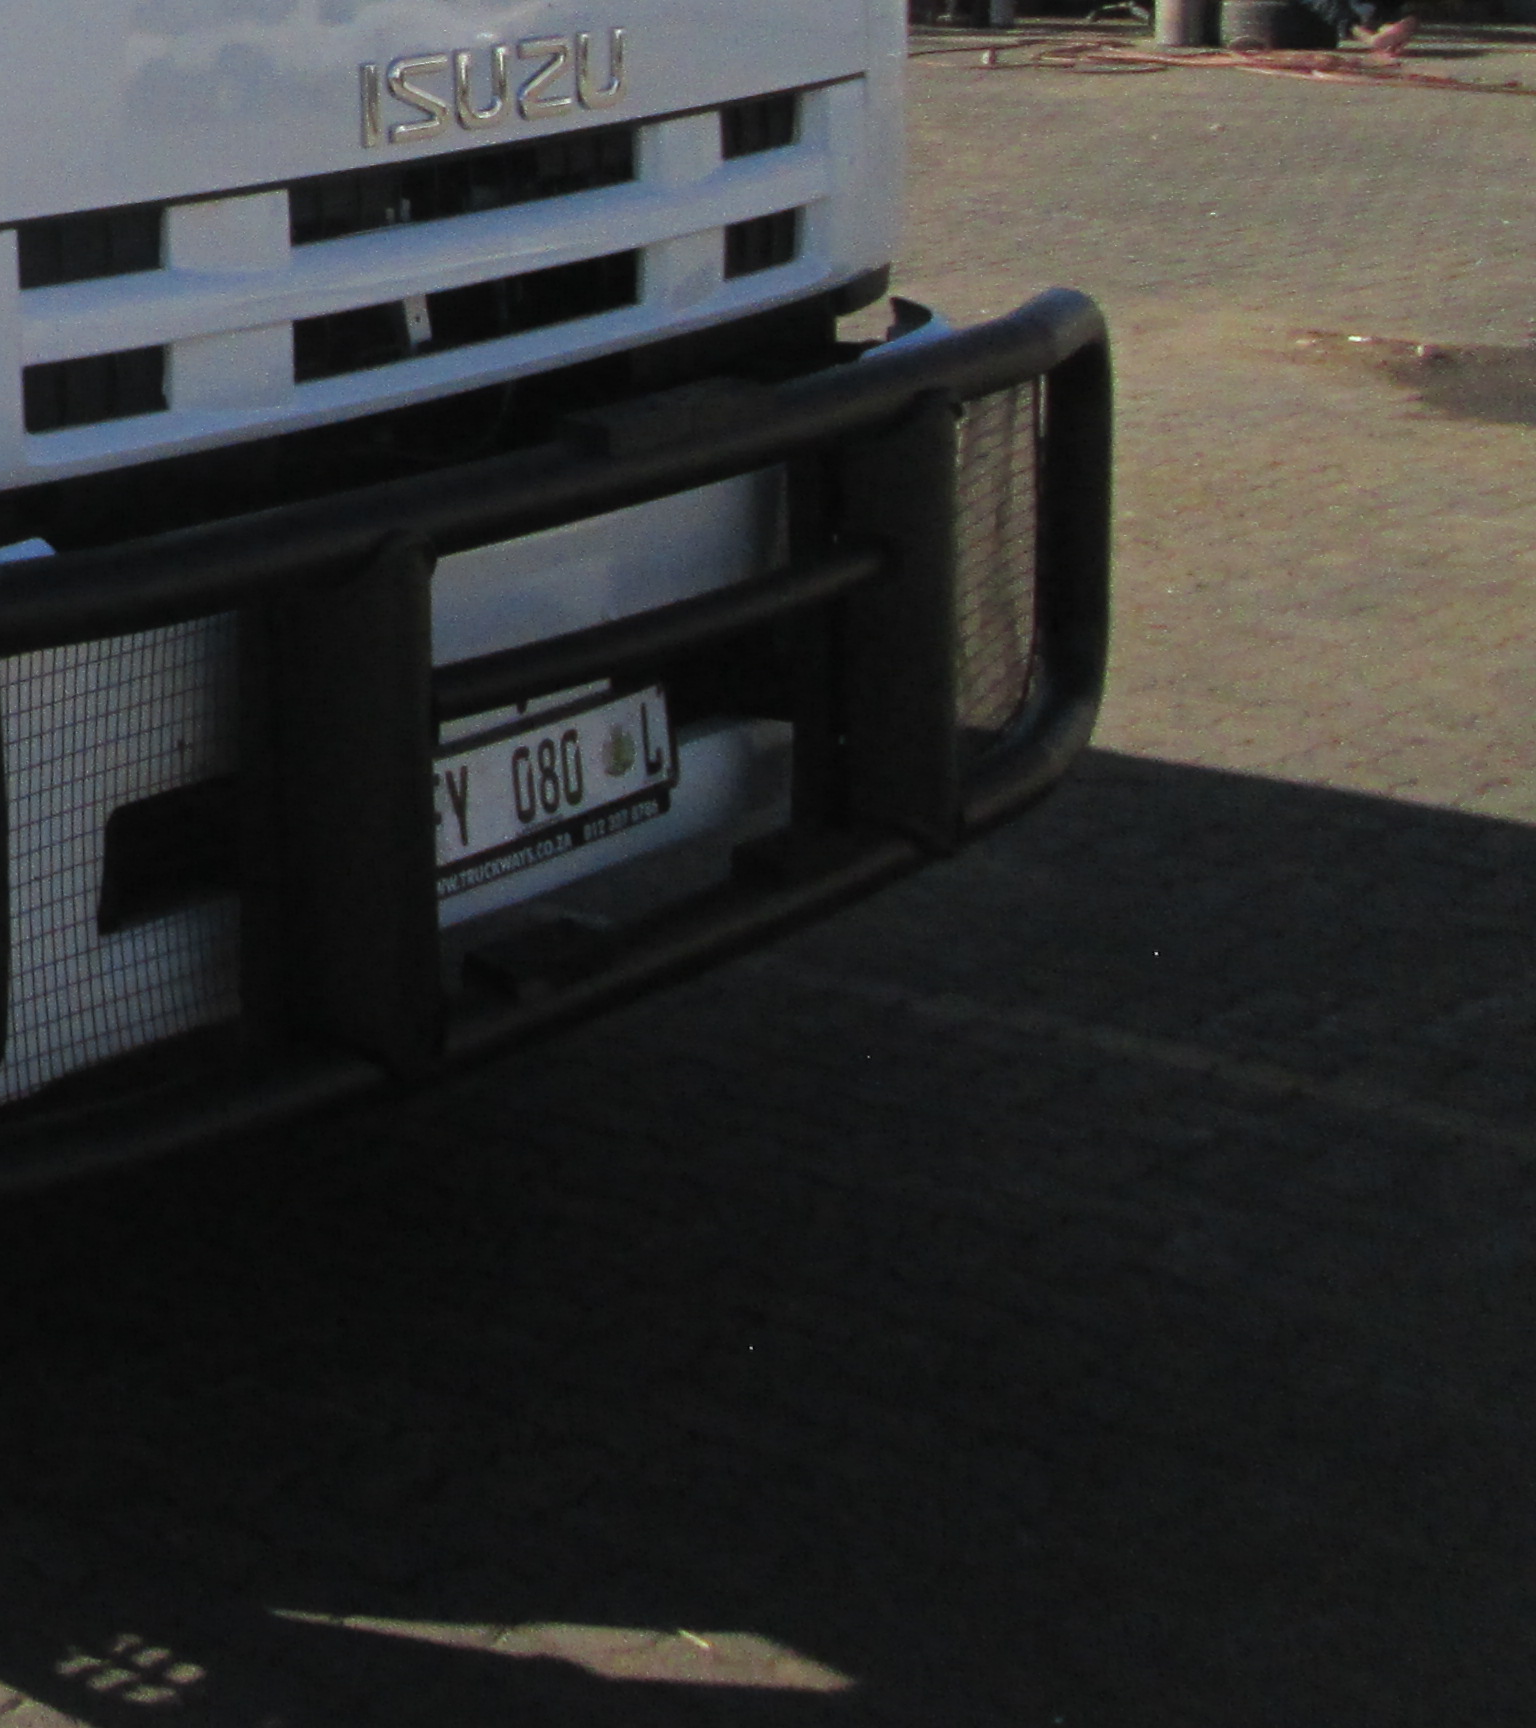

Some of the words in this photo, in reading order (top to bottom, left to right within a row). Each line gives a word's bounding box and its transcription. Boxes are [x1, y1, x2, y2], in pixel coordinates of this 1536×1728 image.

[359, 26, 627, 149] ISUZU
[433, 764, 469, 847] Y
[510, 728, 584, 823] 080
[640, 702, 663, 776] L
